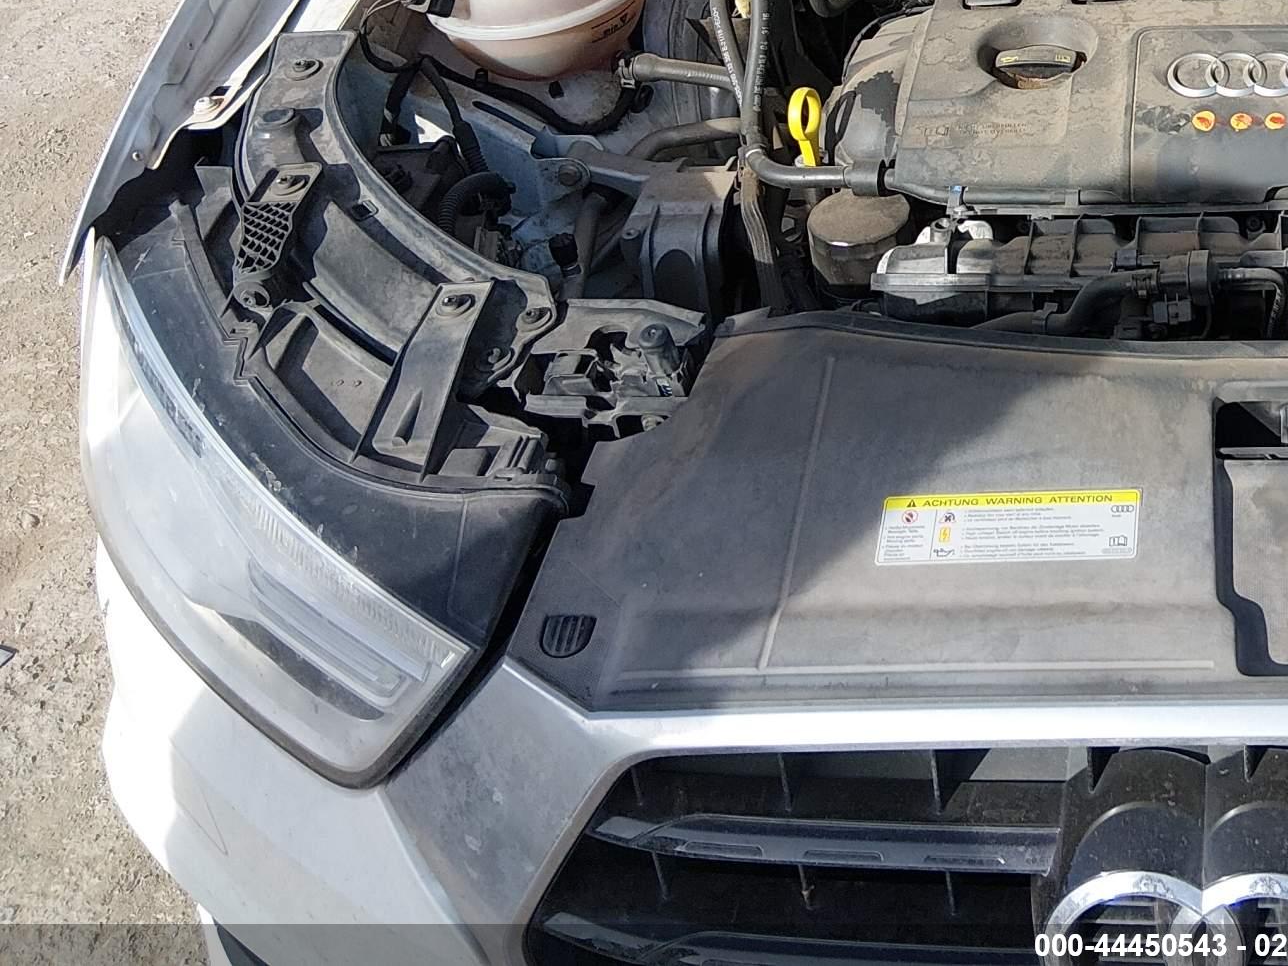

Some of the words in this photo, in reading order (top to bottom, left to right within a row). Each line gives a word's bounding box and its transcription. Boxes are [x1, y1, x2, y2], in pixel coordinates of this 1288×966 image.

[922, 499, 979, 507] ACHTUNG
[986, 497, 1043, 506] WARNING
[1049, 495, 1113, 504] ATTENTION
